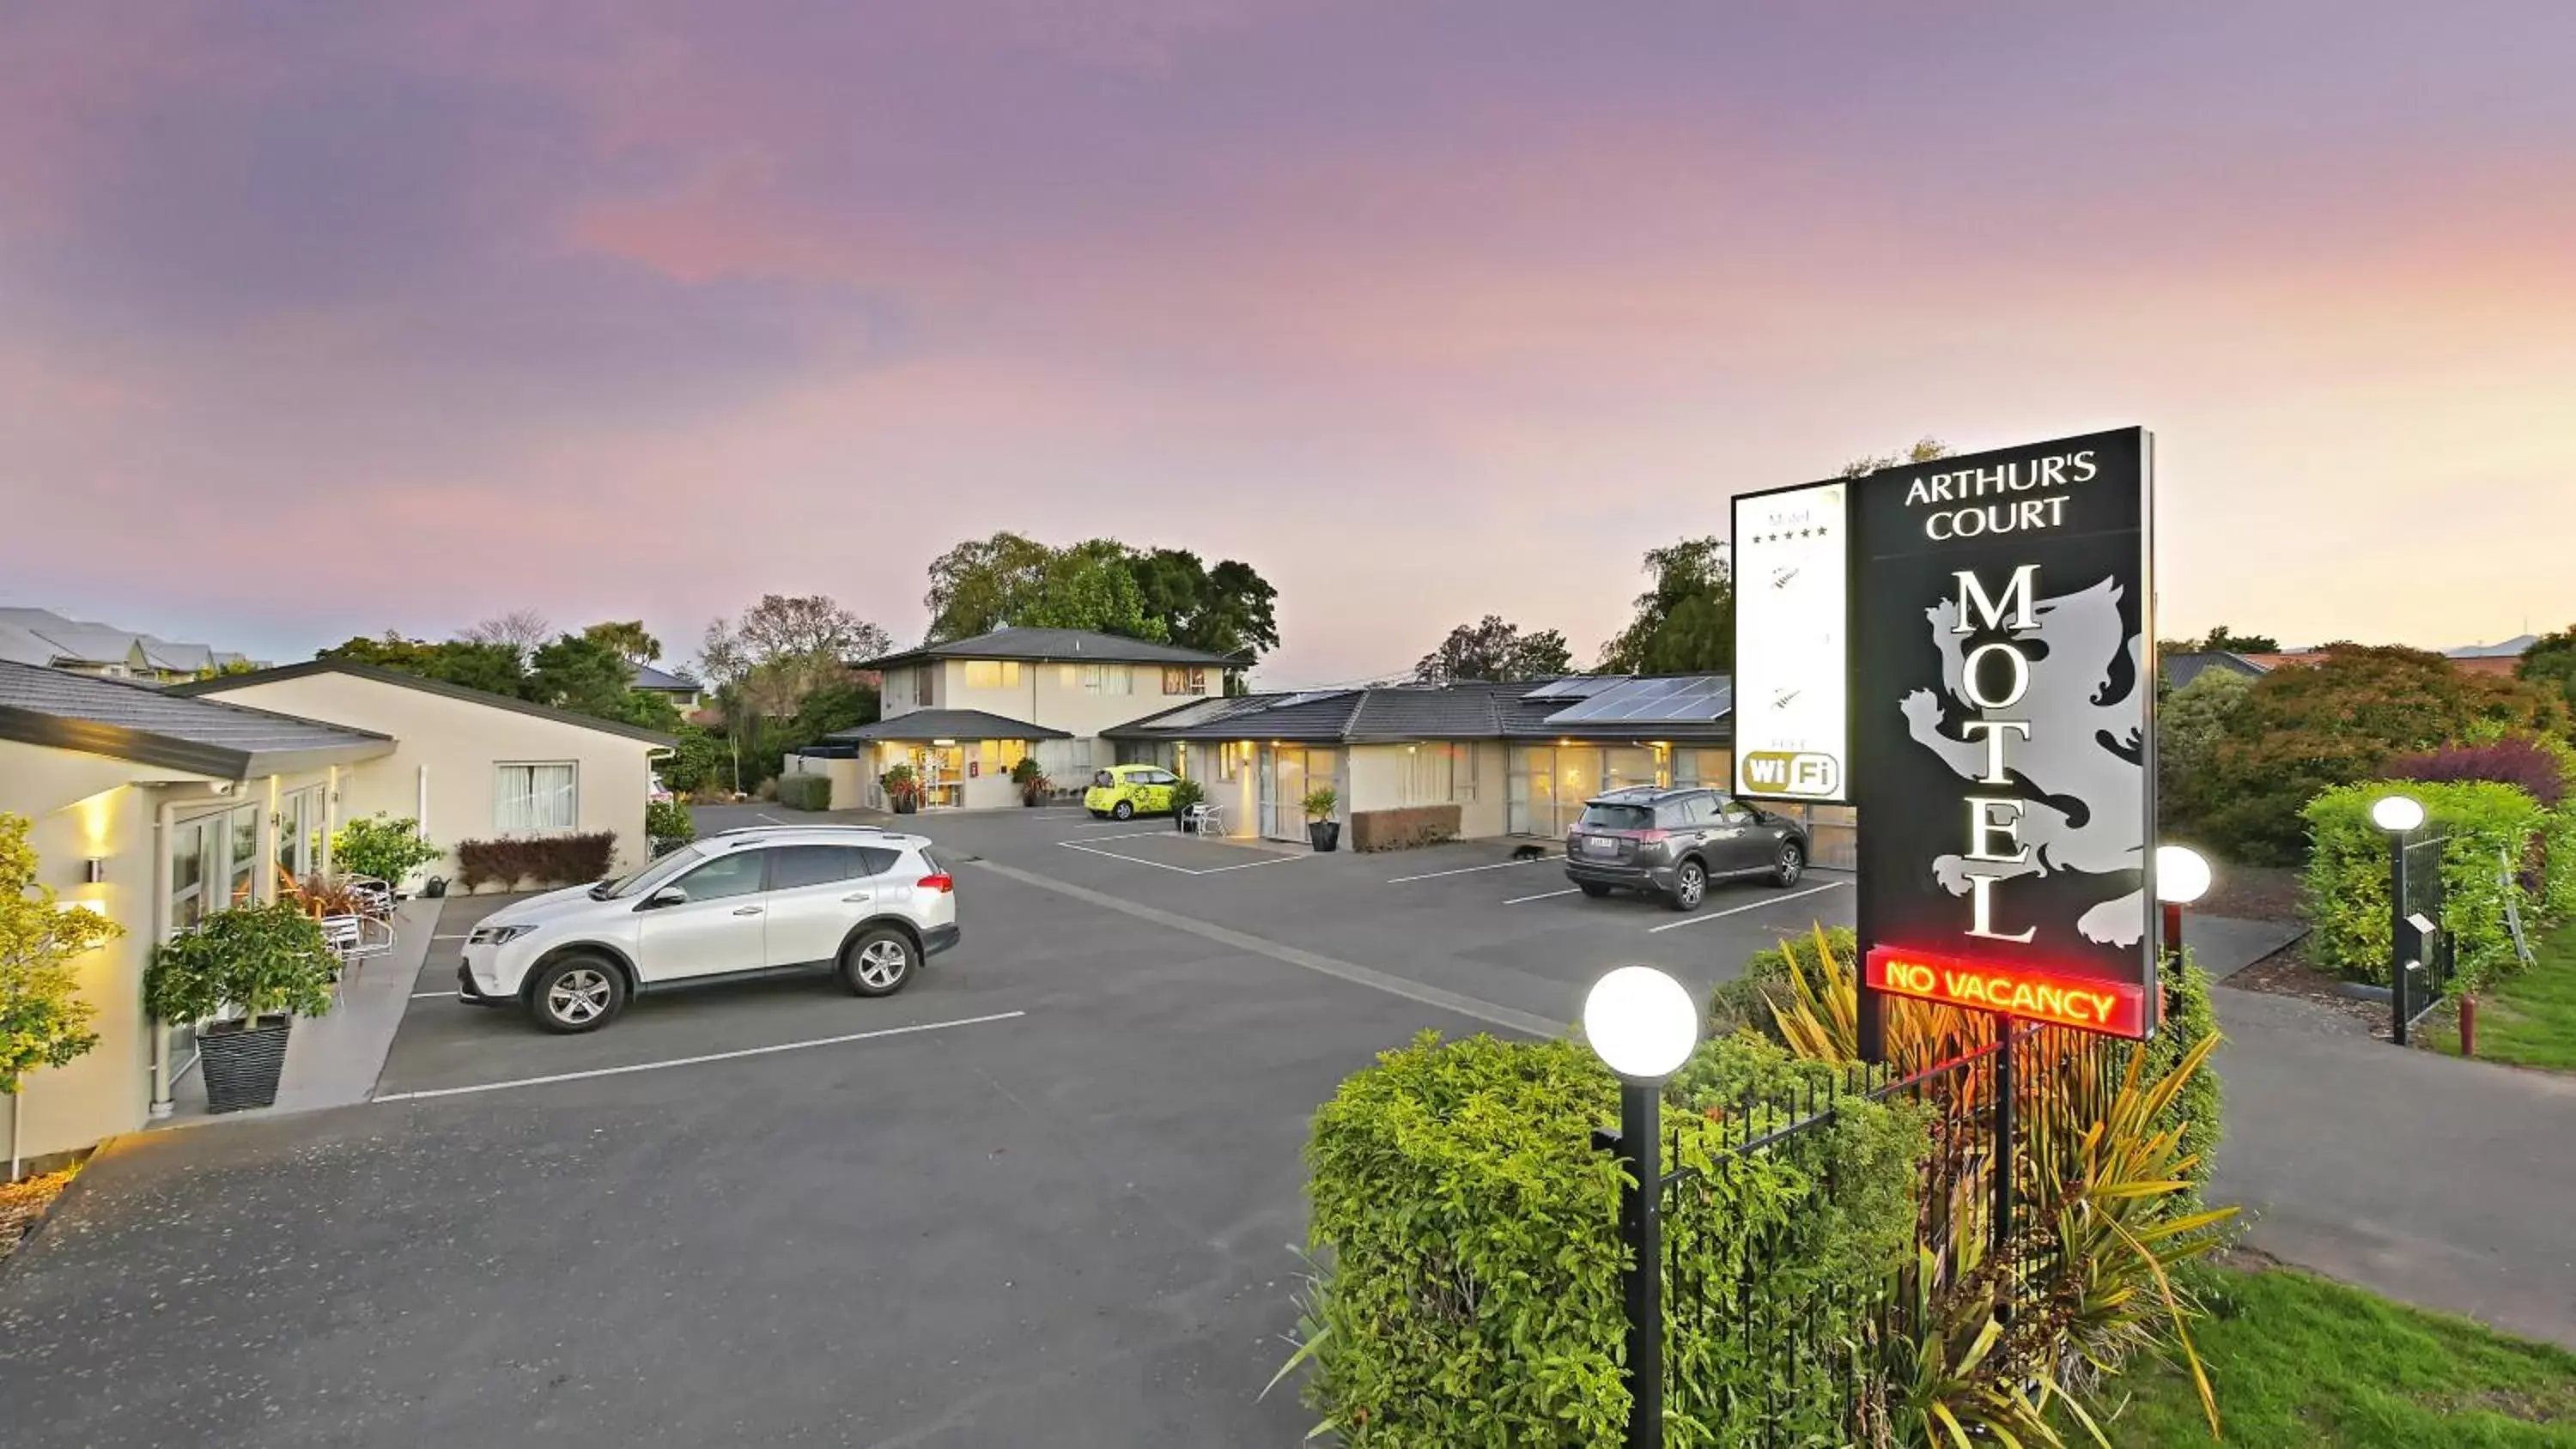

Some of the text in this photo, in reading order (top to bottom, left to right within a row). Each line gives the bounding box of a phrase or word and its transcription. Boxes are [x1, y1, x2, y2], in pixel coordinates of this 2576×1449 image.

[1905, 451, 2097, 506] ARTHUR'S
[1925, 496, 2071, 542] COURT
[1952, 563, 2043, 943] MOTEL
[1887, 961, 2117, 1024] NO VACANCY
